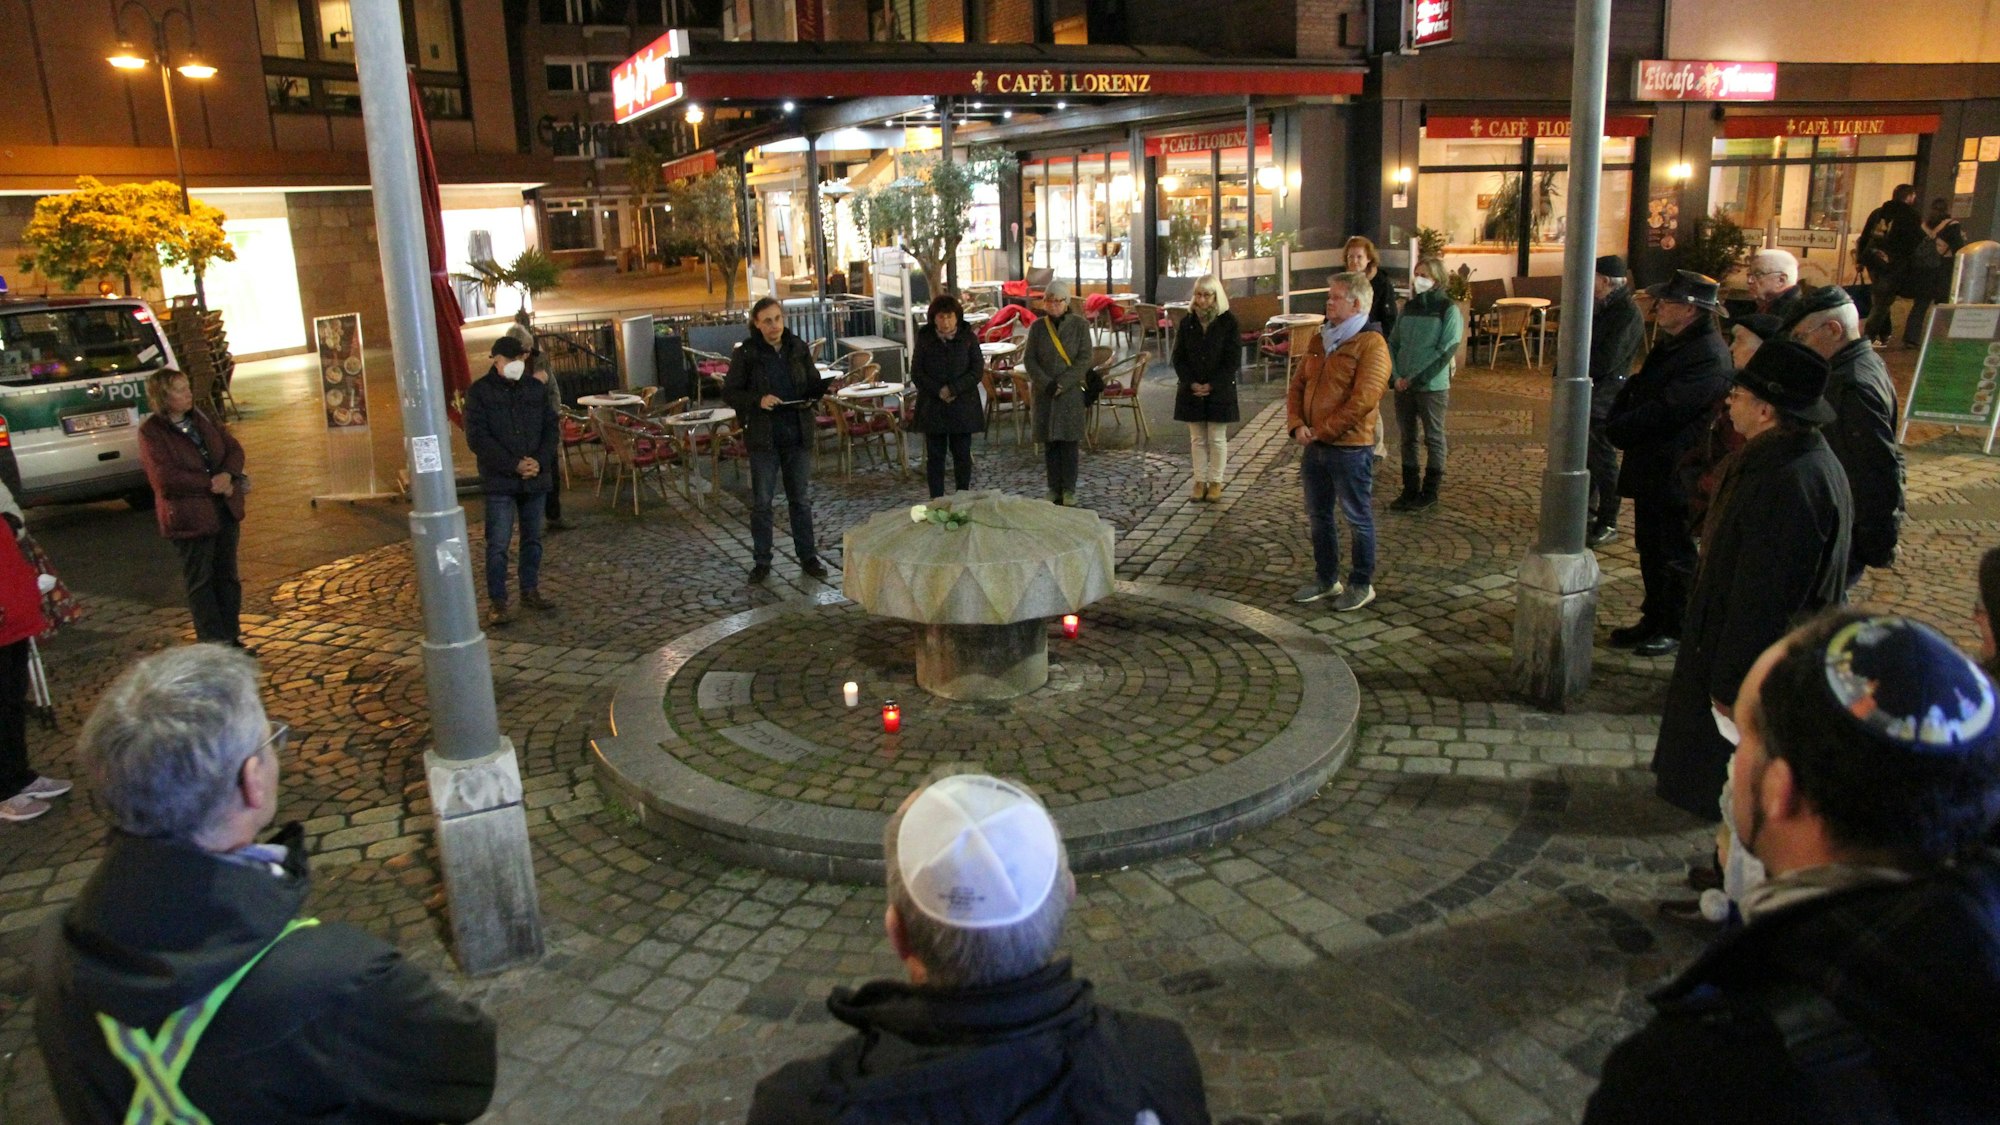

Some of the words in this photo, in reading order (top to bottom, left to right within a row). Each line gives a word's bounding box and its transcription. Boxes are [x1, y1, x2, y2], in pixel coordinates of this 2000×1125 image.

[1059, 73, 1151, 93] FLORENZ
[1644, 63, 1695, 98] Eiscafe
[1537, 120, 1572, 137] FLOR
[108, 383, 142, 401] POL
